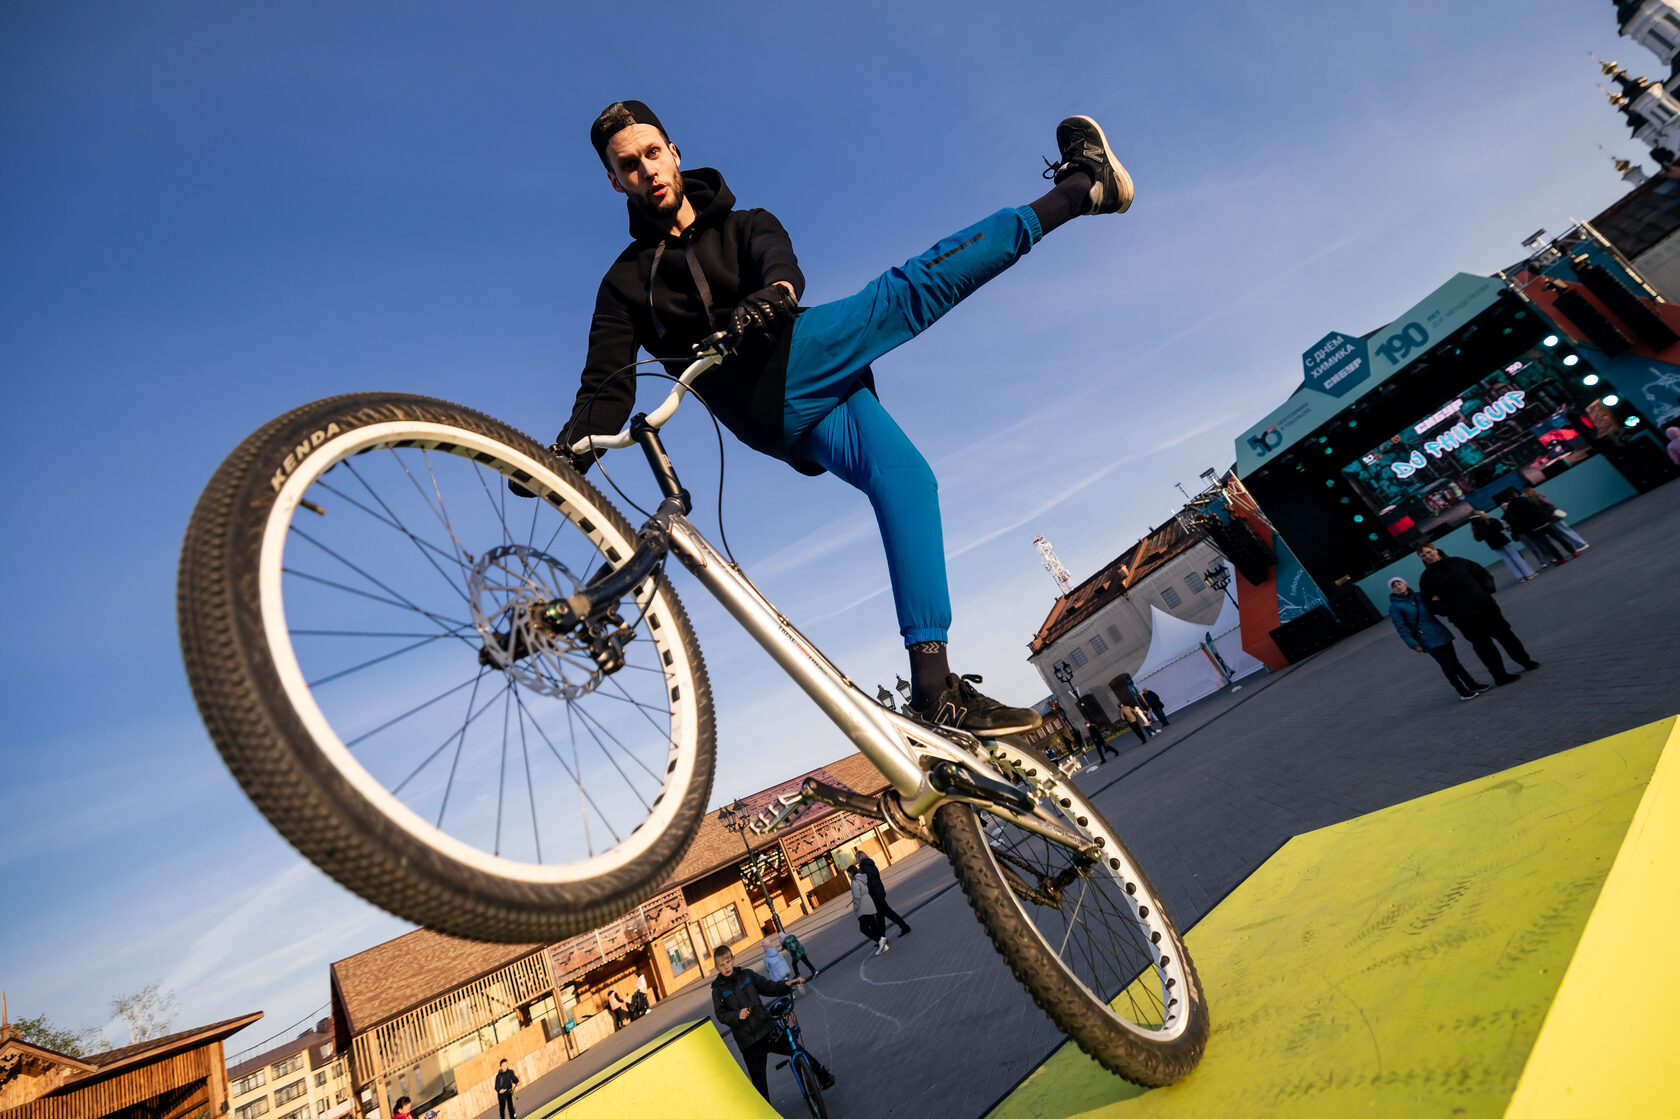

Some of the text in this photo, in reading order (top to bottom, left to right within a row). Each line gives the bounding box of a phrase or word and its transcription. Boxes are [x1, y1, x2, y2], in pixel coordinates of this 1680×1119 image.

[1305, 335, 1344, 367] С ДНЁМ
[1374, 321, 1429, 365] 190
[1310, 344, 1356, 379] ХИМИКА
[1323, 357, 1362, 389] СИБУР
[270, 422, 341, 493] KENDA
[1391, 450, 1427, 478] DJ
[934, 702, 967, 729] N
